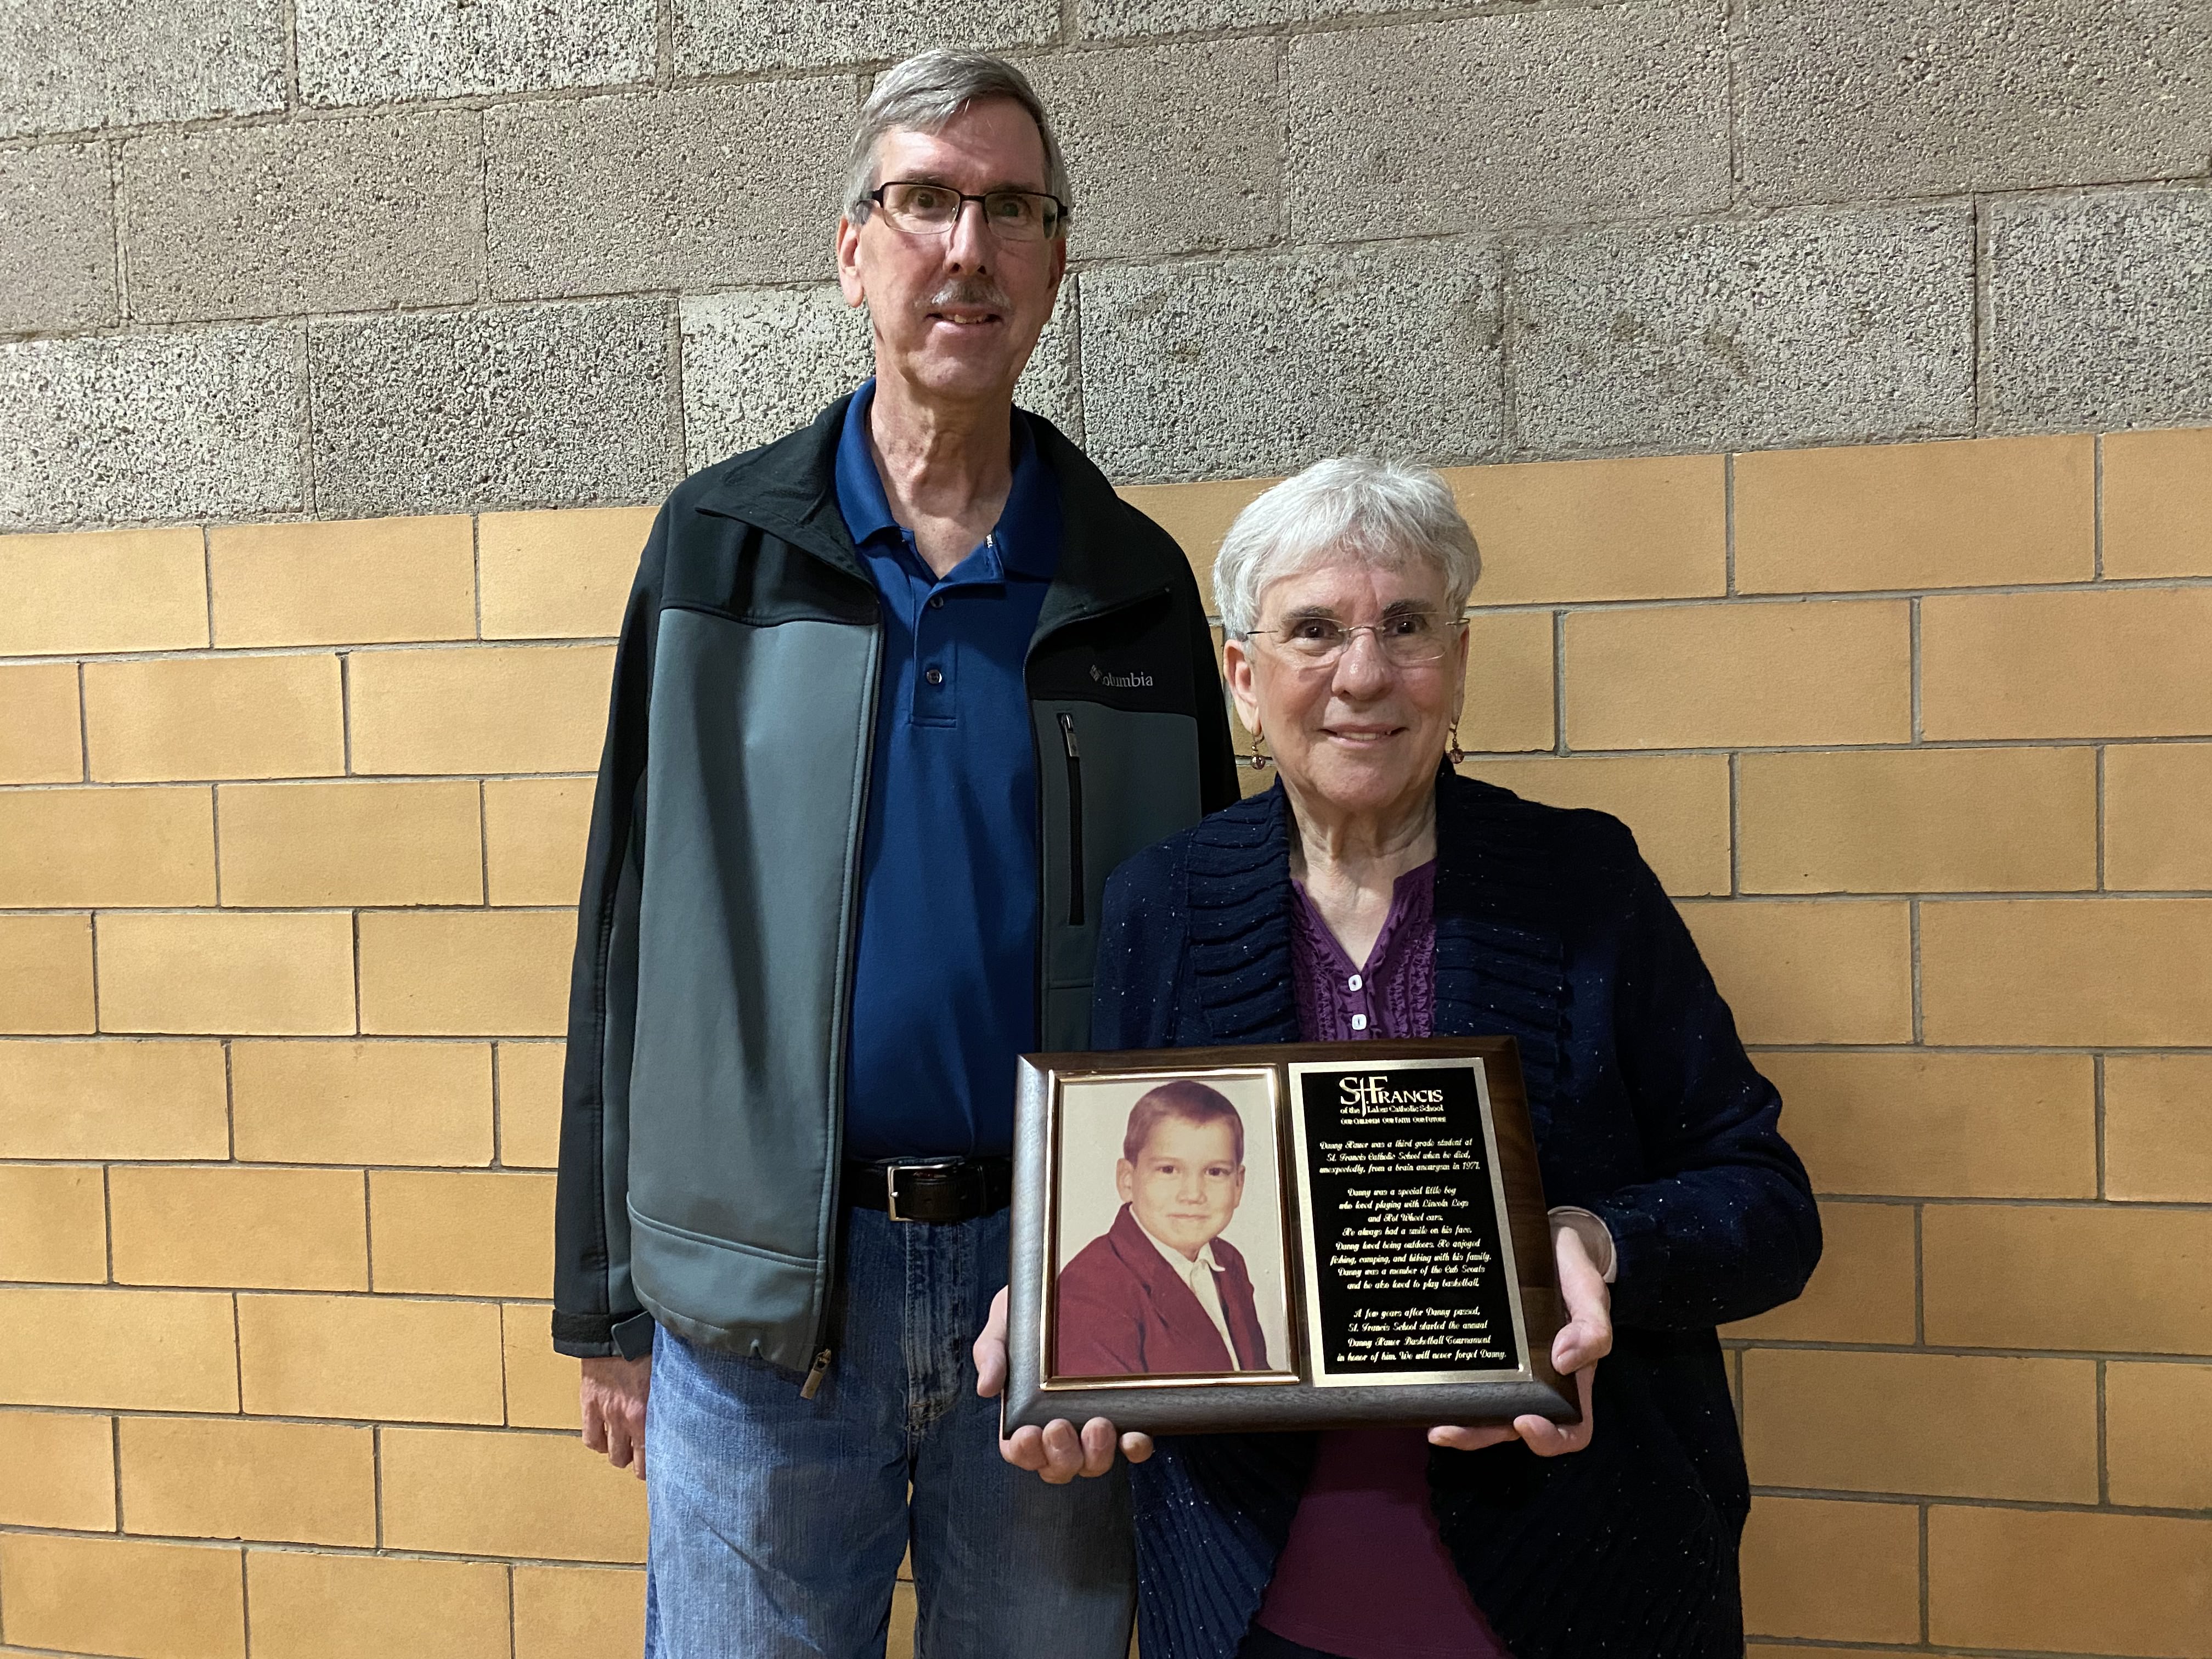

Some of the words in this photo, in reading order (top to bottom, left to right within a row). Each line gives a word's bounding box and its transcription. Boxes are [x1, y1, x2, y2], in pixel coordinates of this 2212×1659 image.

[1102, 672, 1153, 687] olumbia
[1320, 1142, 1342, 1151] Danny
[1415, 1139, 1434, 1149] grade
[1327, 1153, 1336, 1161] St.
[1368, 1152, 1395, 1160] Catholic
[1398, 1151, 1421, 1159] School
[1454, 1150, 1470, 1159] died,
[1368, 1164, 1385, 1173] from
[1347, 1188, 1371, 1198] Danny
[1398, 1186, 1423, 1197] special
[1425, 1186, 1441, 1194] little
[1444, 1186, 1456, 1196] boy
[1339, 1201, 1352, 1209] who
[1356, 1200, 1373, 1209] loved
[1375, 1200, 1401, 1211] playing
[1404, 1199, 1419, 1207] with
[1423, 1199, 1448, 1207] Lincoln
[1452, 1199, 1469, 1208] Logs
[1368, 1214, 1381, 1222] and
[1401, 1213, 1424, 1221] Wheel
[1342, 1228, 1355, 1236] He
[1358, 1227, 1382, 1238] always
[1385, 1227, 1398, 1235] had
[1409, 1226, 1427, 1234] smile
[1441, 1225, 1452, 1233] his
[1455, 1225, 1472, 1235] face.
[1336, 1242, 1359, 1251] Danny
[1362, 1240, 1380, 1249] loved
[1383, 1241, 1401, 1250] being
[1453, 1238, 1481, 1249] enjoyed
[1330, 1255, 1356, 1266] fishing,
[1359, 1255, 1390, 1265] camping,
[1393, 1254, 1407, 1262] and
[1409, 1253, 1431, 1263] hiking
[1434, 1252, 1449, 1261] with
[1452, 1252, 1463, 1261] his
[1466, 1252, 1491, 1262] family.
[1338, 1268, 1362, 1278] Danny
[1390, 1266, 1417, 1274] member
[1420, 1266, 1429, 1275] of
[1431, 1265, 1442, 1273] the
[1462, 1265, 1485, 1273] Scouts
[1347, 1280, 1362, 1289] and
[1363, 1280, 1372, 1289] he
[1375, 1280, 1389, 1289] also
[1392, 1279, 1410, 1288] loved
[1413, 1279, 1420, 1288] to
[1423, 1279, 1439, 1290] play
[1353, 1308, 1362, 1317] A
[1365, 1308, 1379, 1319] few
[1381, 1311, 1402, 1319] years
[1404, 1308, 1423, 1318] after
[1426, 1307, 1451, 1318] Danny
[1453, 1306, 1480, 1318] passed,
[1348, 1323, 1358, 1331] St.
[1362, 1323, 1390, 1331] Francis
[1393, 1321, 1417, 1330] School
[1419, 1321, 1446, 1330] started
[1448, 1321, 1459, 1329] the
[1463, 1320, 1488, 1329] annual
[1348, 1338, 1372, 1348] Danny
[1404, 1335, 1444, 1345] Basketball
[1446, 1335, 1491, 1344] Tournament
[1347, 1352, 1368, 1361] honor
[1370, 1352, 1379, 1363] of
[1381, 1352, 1396, 1360] him.
[1399, 1351, 1413, 1359] We
[1415, 1350, 1430, 1359] will
[1455, 1350, 1477, 1361] forget
[1480, 1349, 1506, 1359] Danny.
